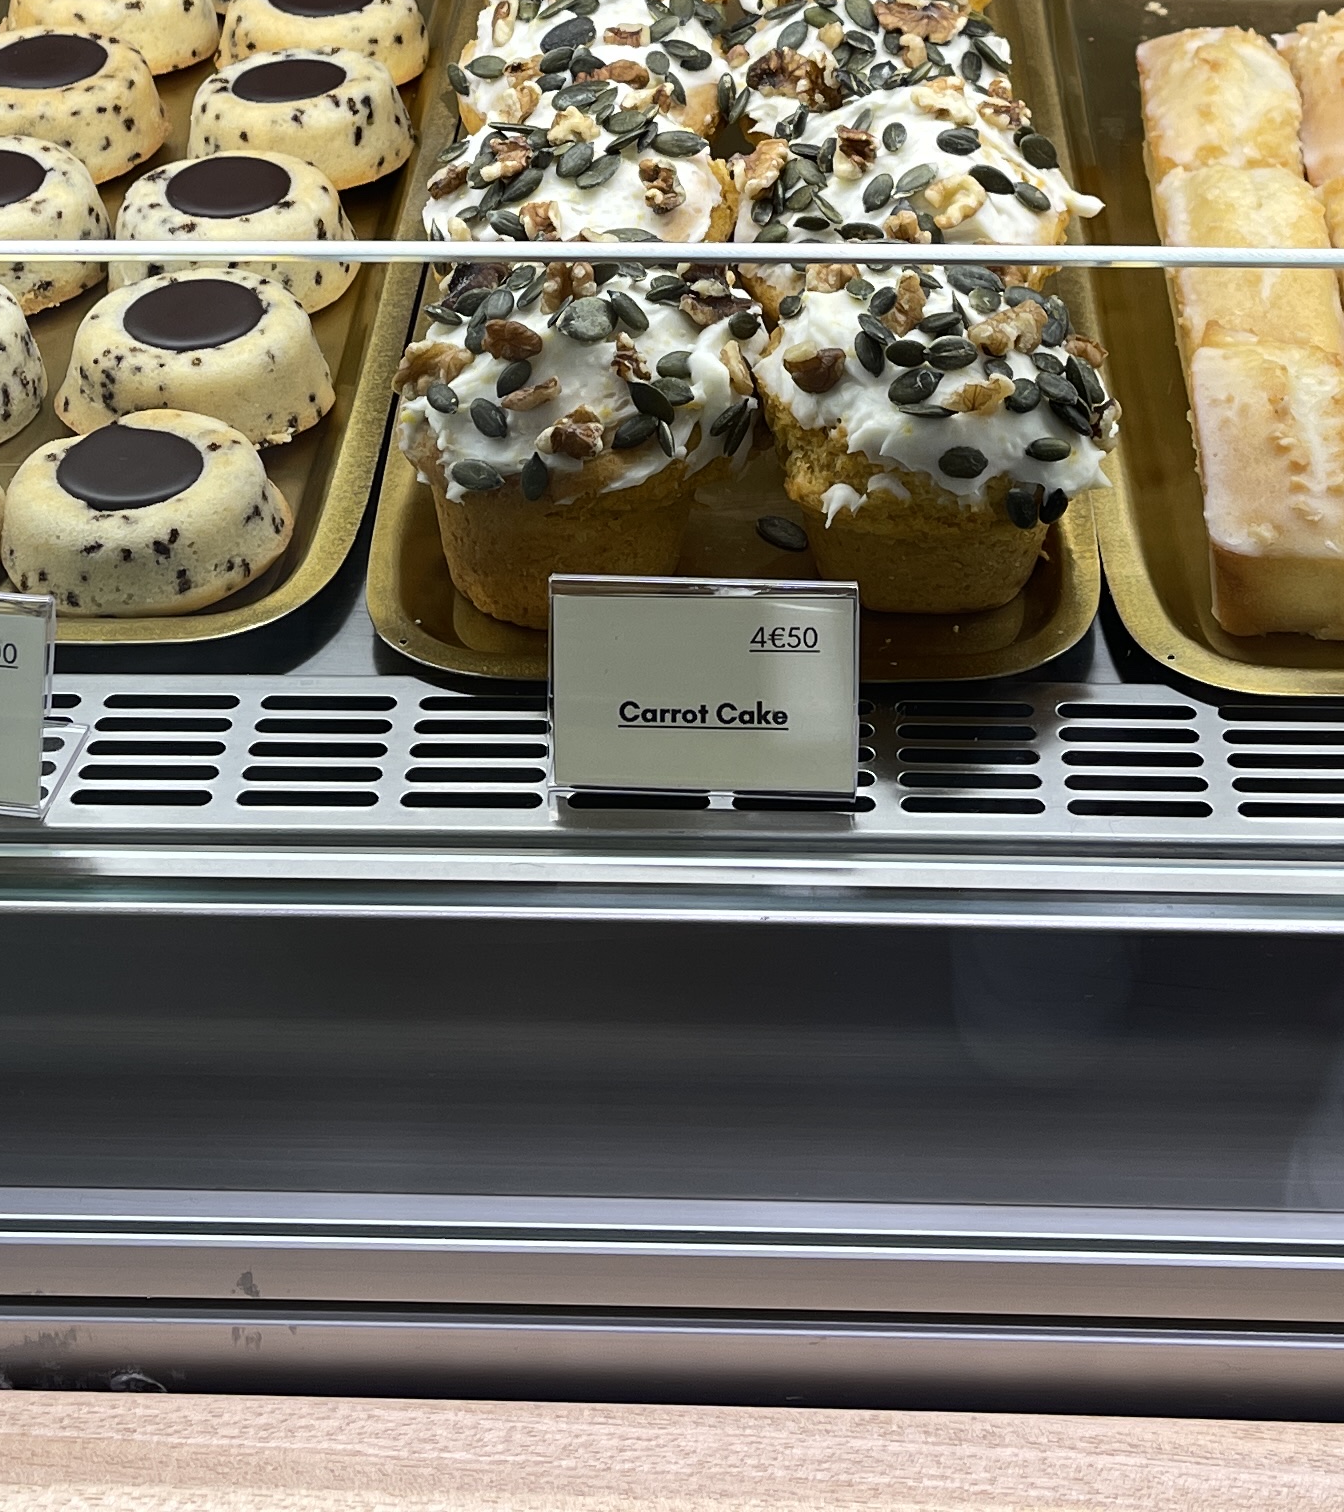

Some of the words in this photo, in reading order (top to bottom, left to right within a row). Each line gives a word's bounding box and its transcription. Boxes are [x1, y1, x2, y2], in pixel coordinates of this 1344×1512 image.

[750, 626, 819, 650] 4€50
[618, 700, 709, 724] Carrot
[715, 700, 789, 726] Cake
